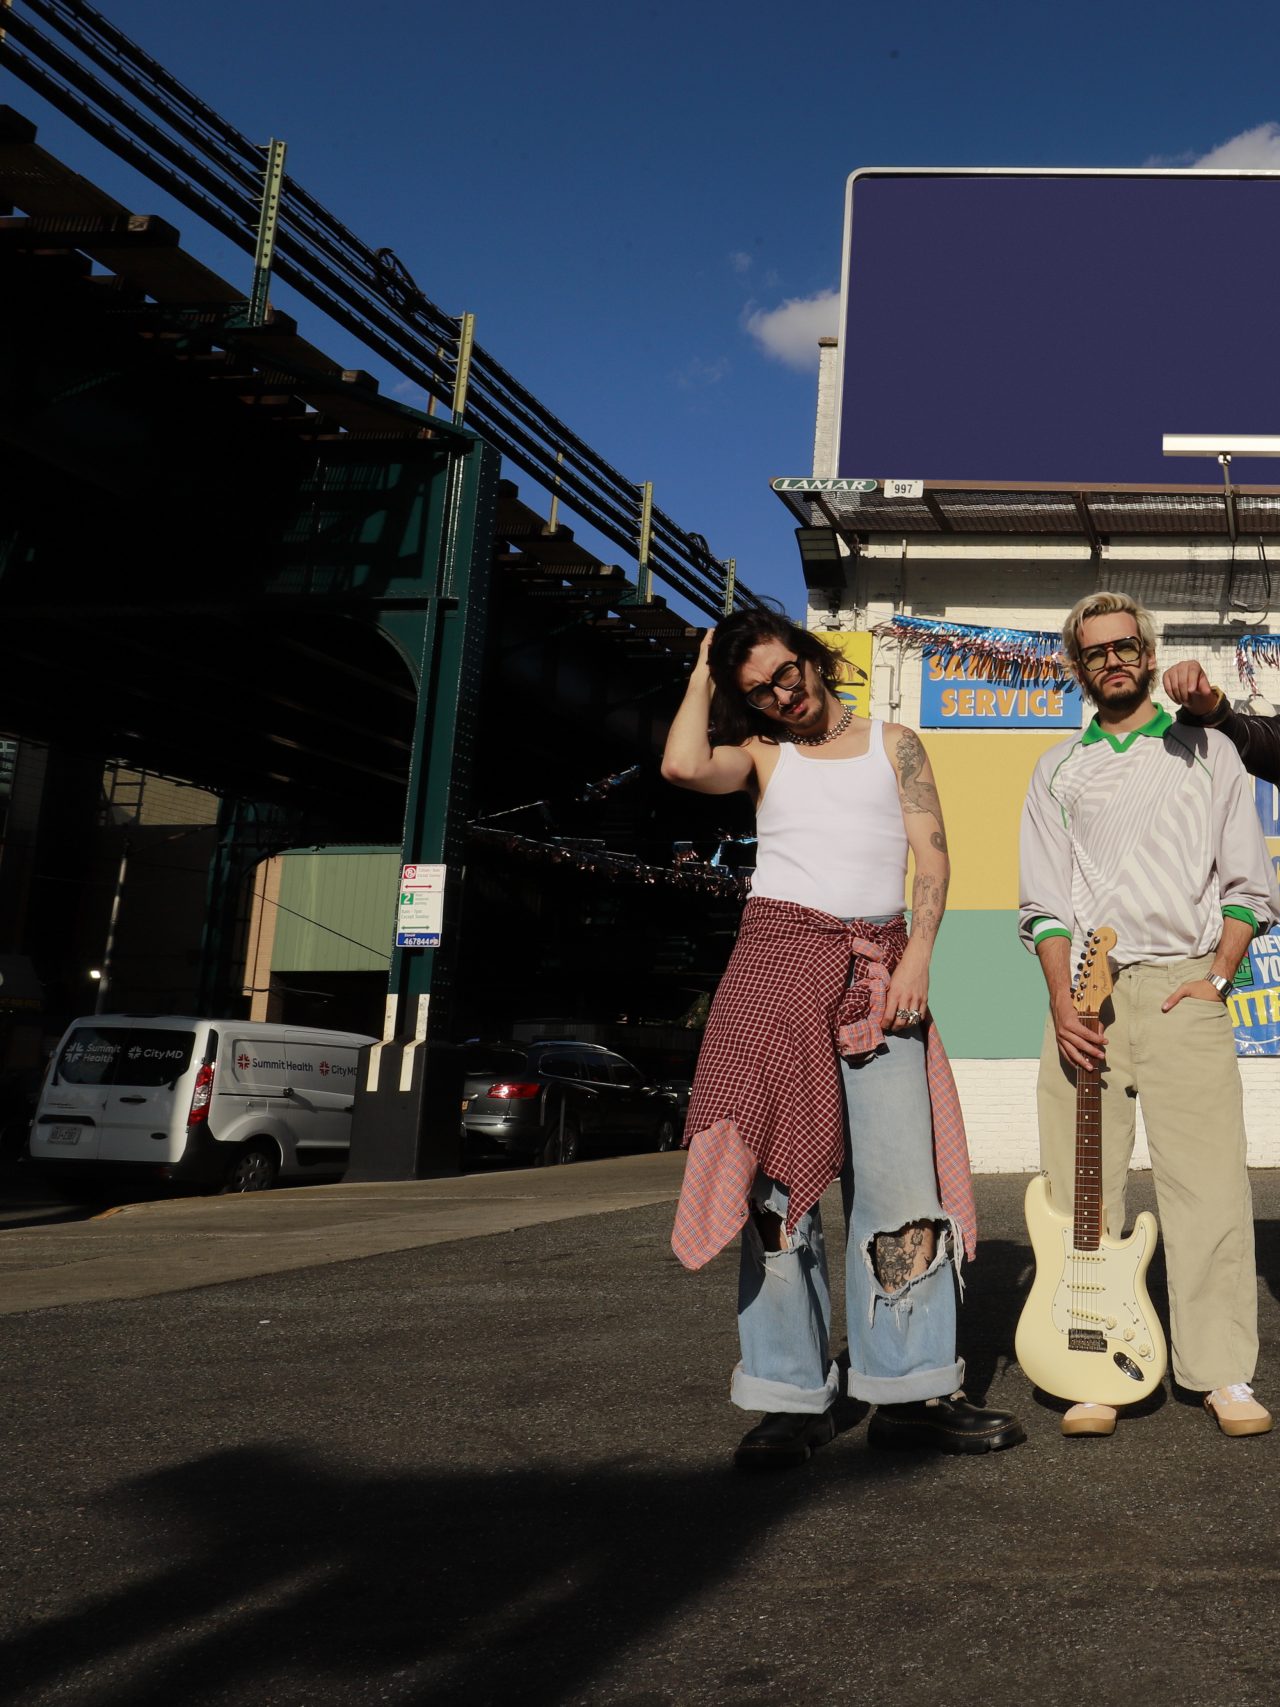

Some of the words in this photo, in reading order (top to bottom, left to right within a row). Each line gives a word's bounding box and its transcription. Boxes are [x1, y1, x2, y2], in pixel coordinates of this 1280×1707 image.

[780, 480, 867, 490] LAMAR
[894, 484, 913, 494] 997
[940, 688, 1063, 717] SERVICE
[403, 893, 411, 904] 2
[86, 1043, 122, 1053] Summit
[82, 1053, 114, 1063] Health
[252, 1058, 285, 1070] Summit
[286, 1061, 314, 1073] Health
